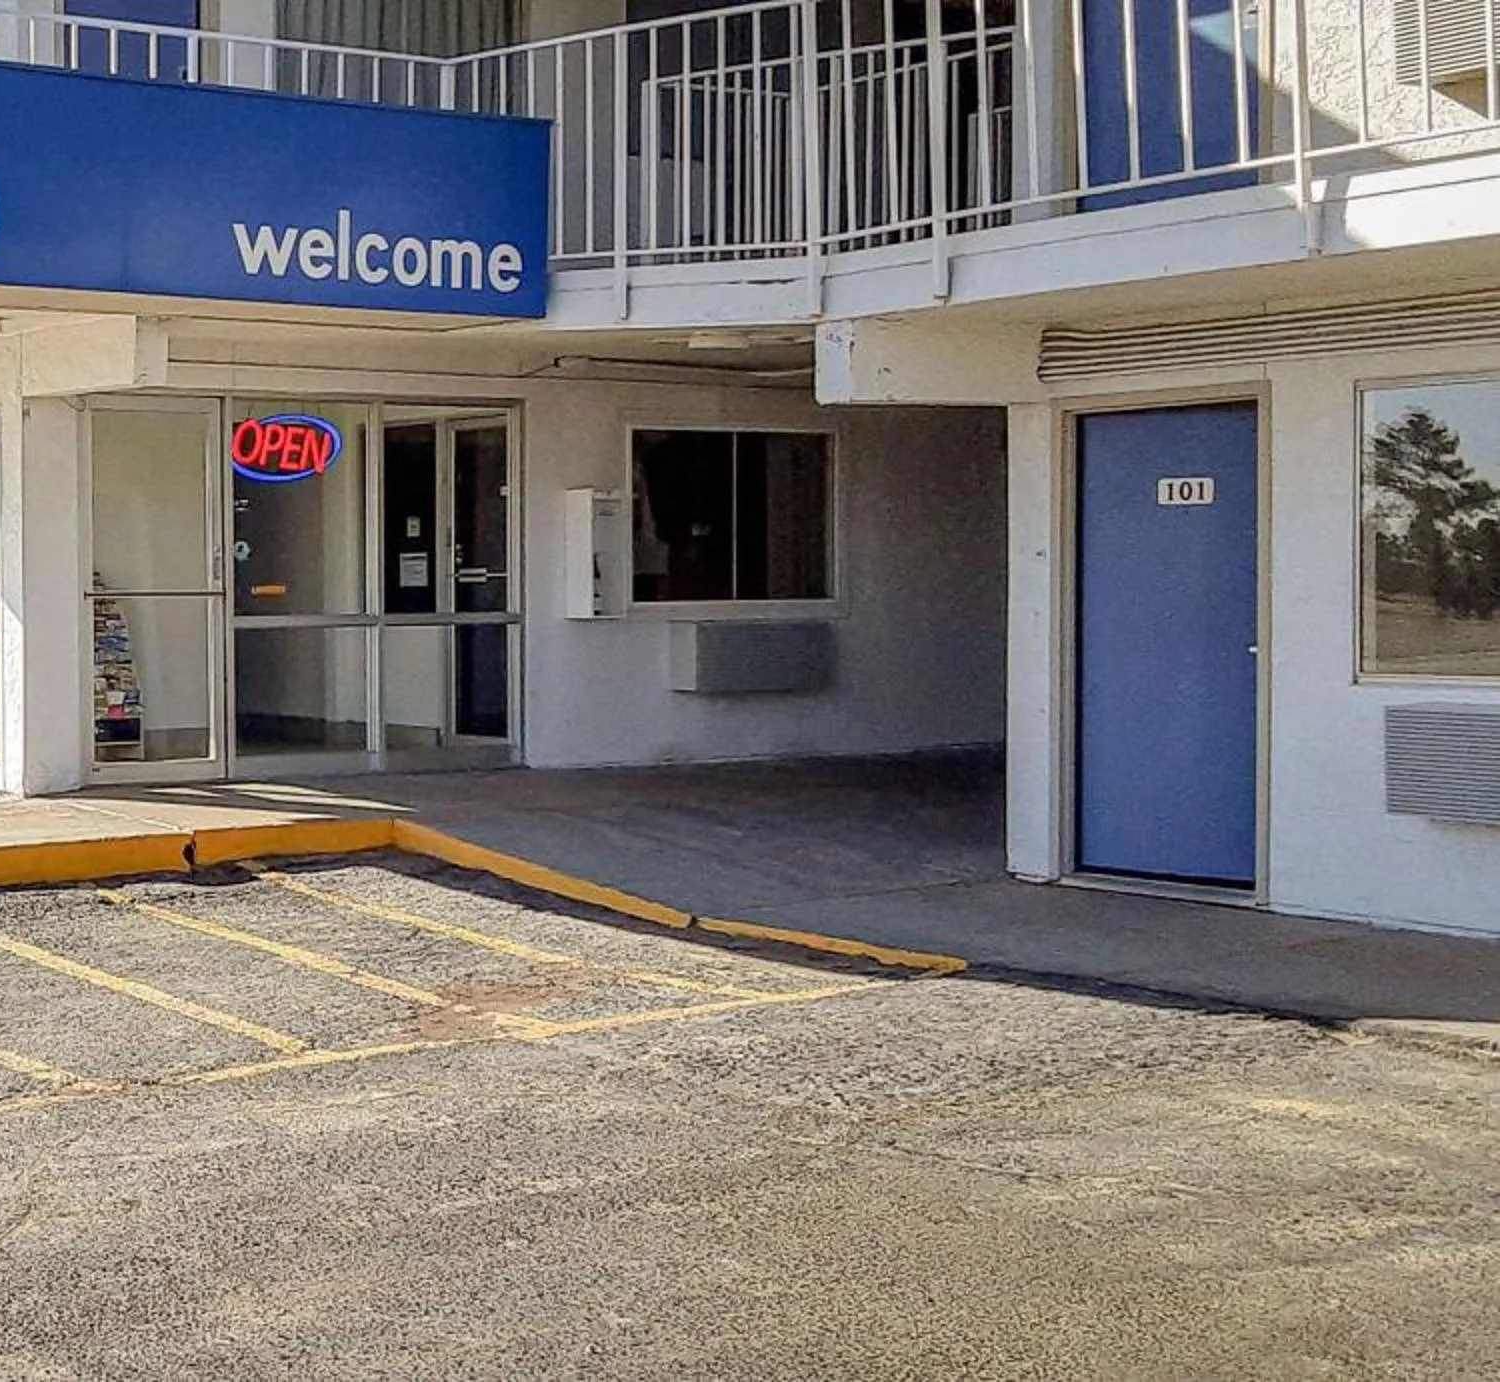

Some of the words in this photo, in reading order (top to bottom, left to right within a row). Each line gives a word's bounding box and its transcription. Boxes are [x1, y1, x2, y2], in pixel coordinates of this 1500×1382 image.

[232, 209, 523, 293] welcome
[232, 419, 331, 473] OPEN
[1166, 481, 1205, 501] 101
